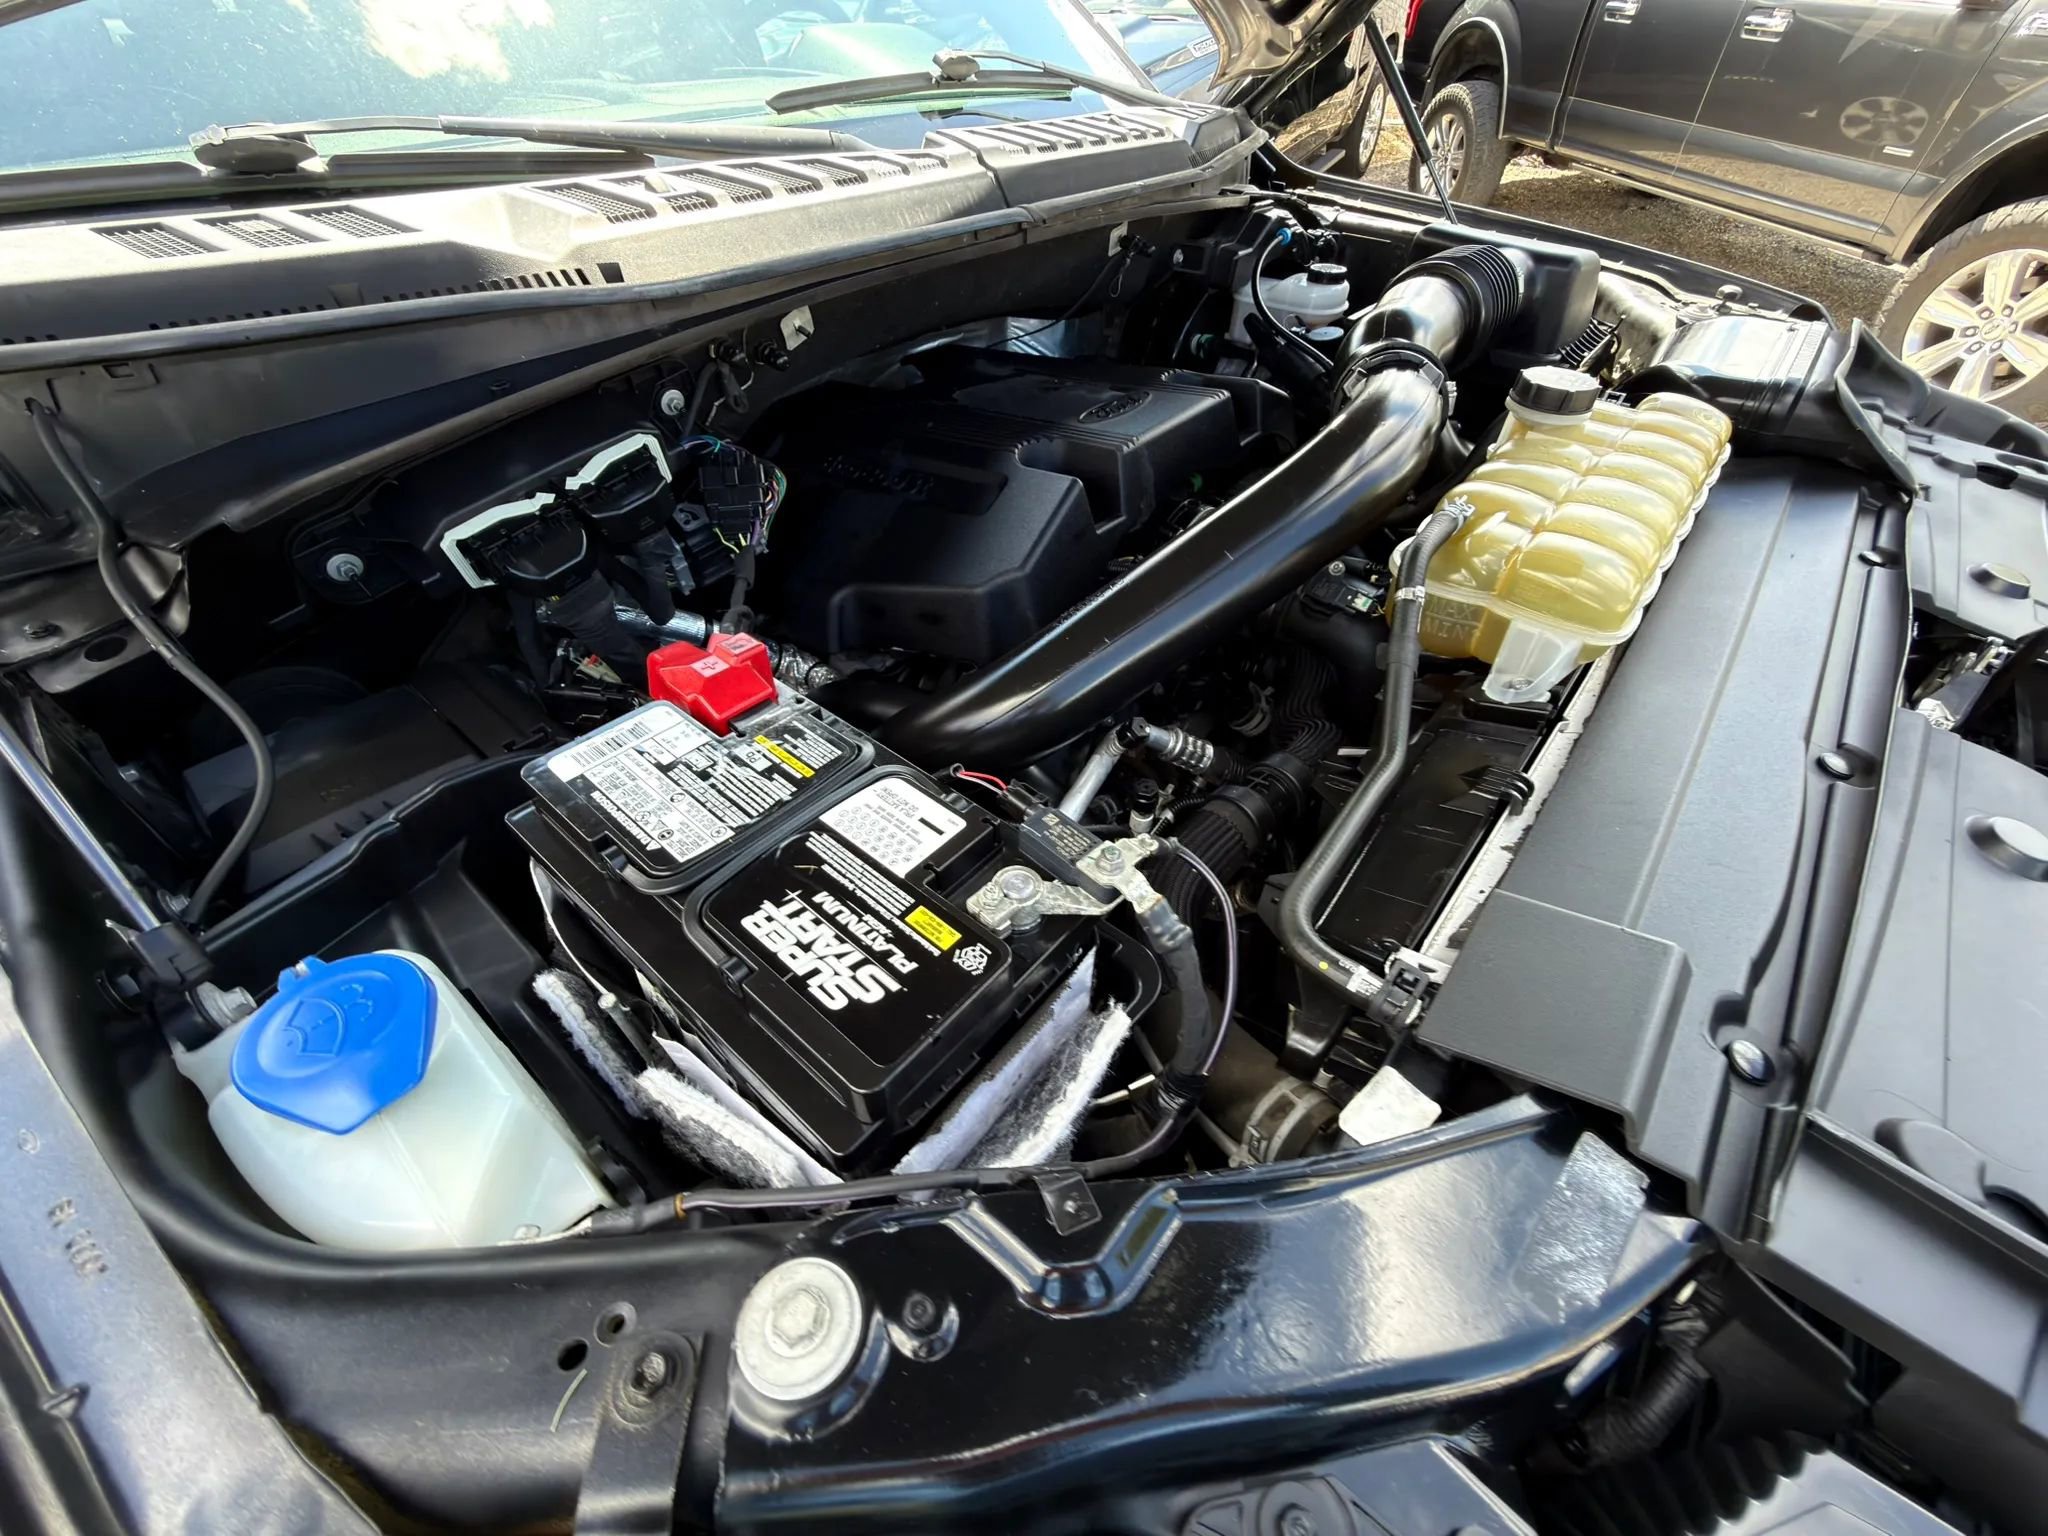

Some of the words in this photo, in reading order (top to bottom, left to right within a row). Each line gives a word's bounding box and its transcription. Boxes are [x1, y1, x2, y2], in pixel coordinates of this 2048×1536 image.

[1423, 617, 1469, 640] MIN
[1428, 597, 1473, 620] MAX
[740, 909, 849, 1011] SUPER
[760, 900, 902, 1004] START
[811, 890, 919, 974] PLATINUM
